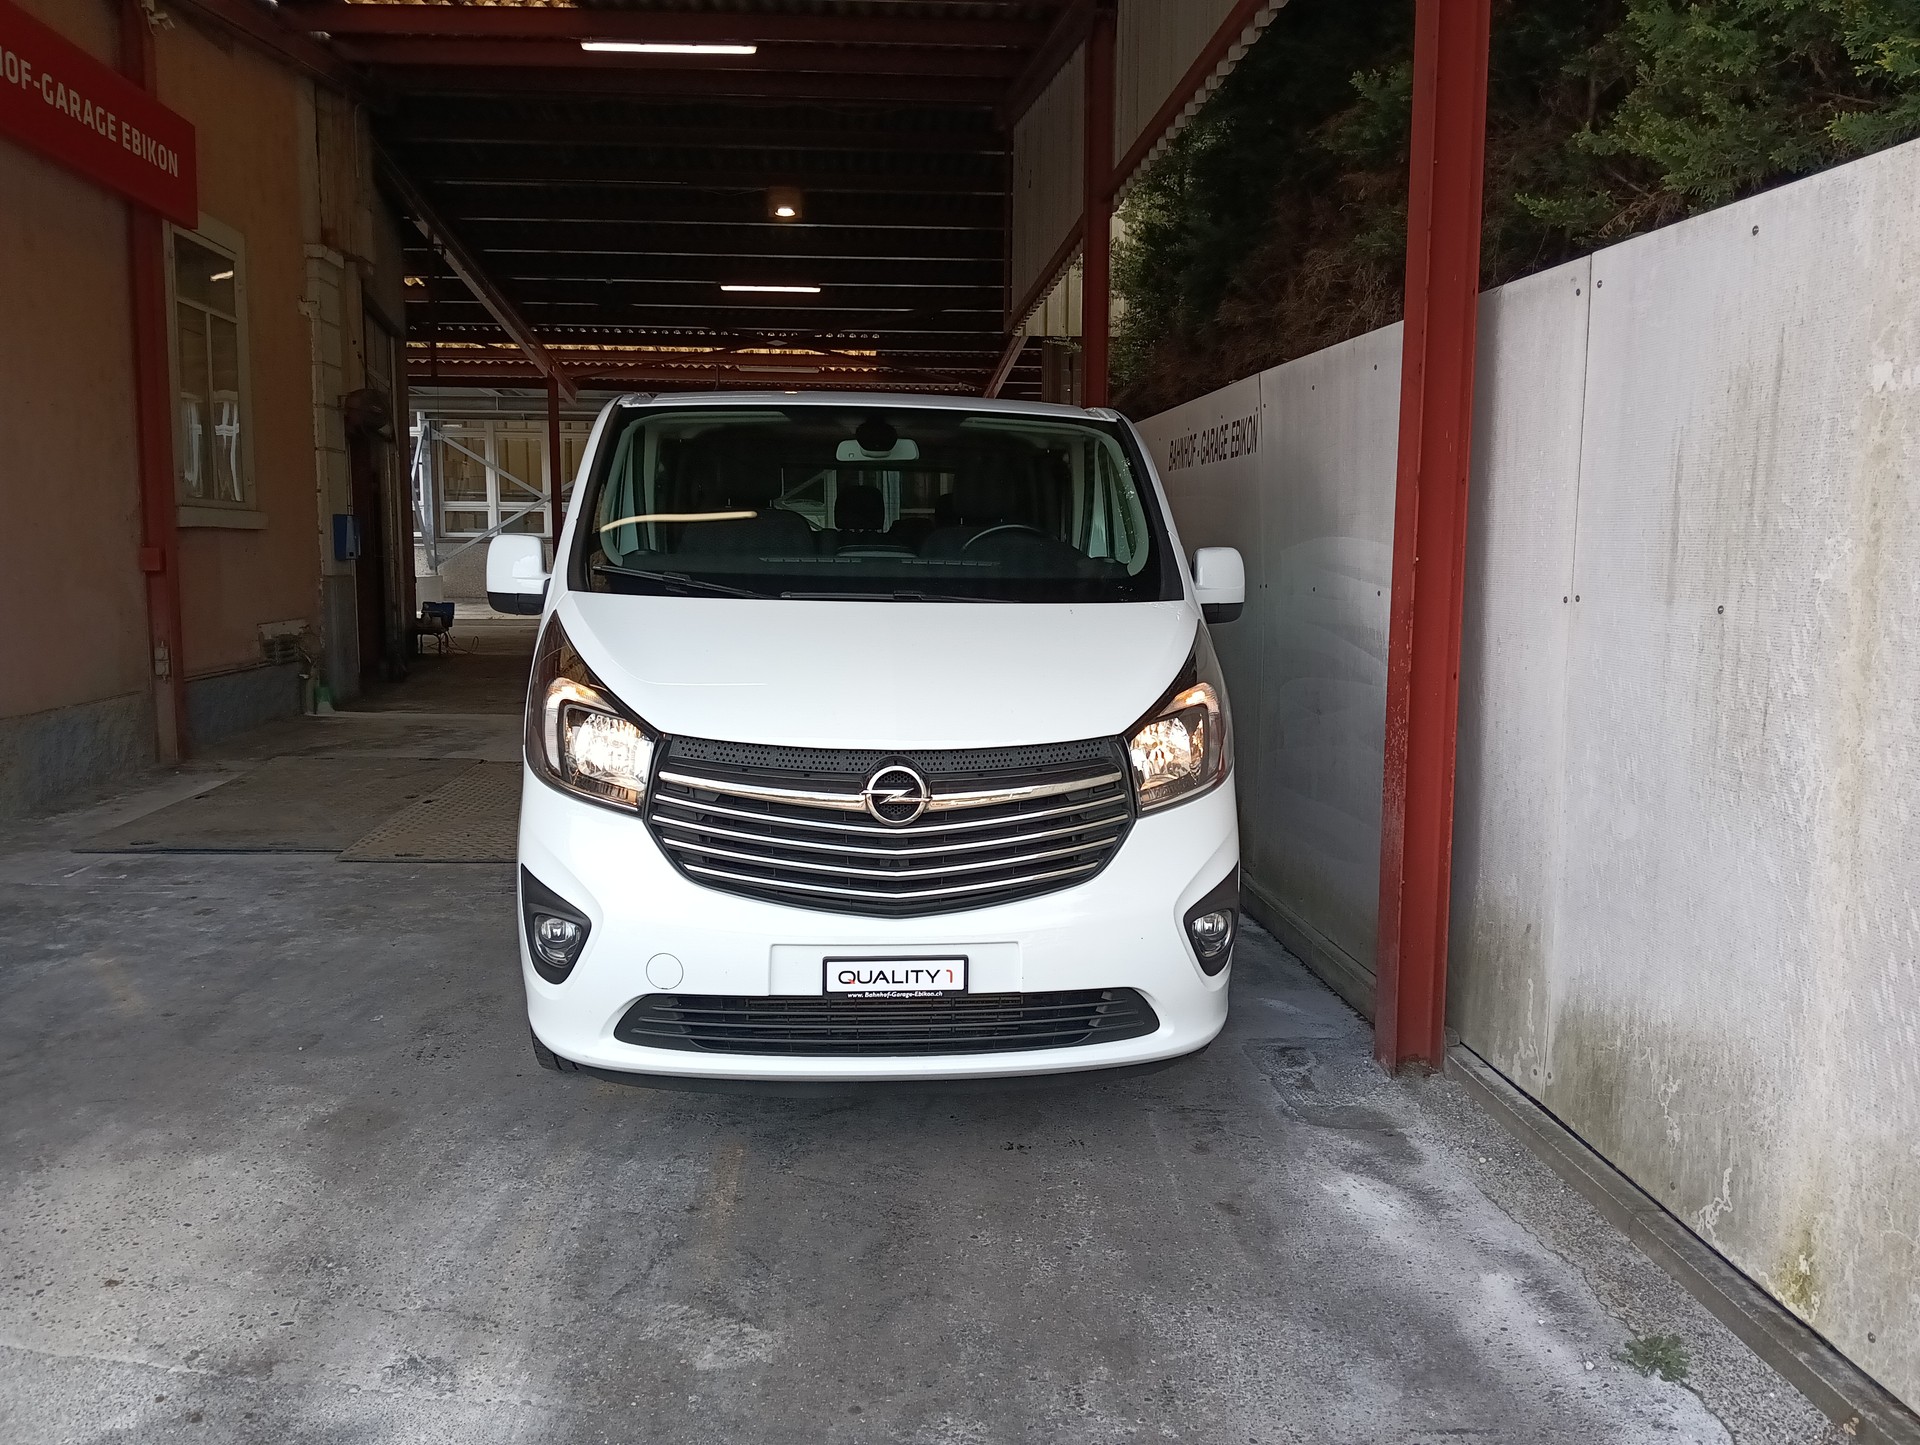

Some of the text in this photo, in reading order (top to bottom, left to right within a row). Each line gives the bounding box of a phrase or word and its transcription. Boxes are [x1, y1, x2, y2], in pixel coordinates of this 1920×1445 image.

[0, 45, 179, 178] OF-GARAGE EBIKON
[1230, 414, 1259, 458] EBIKON
[838, 969, 953, 984] QUALITY 1
